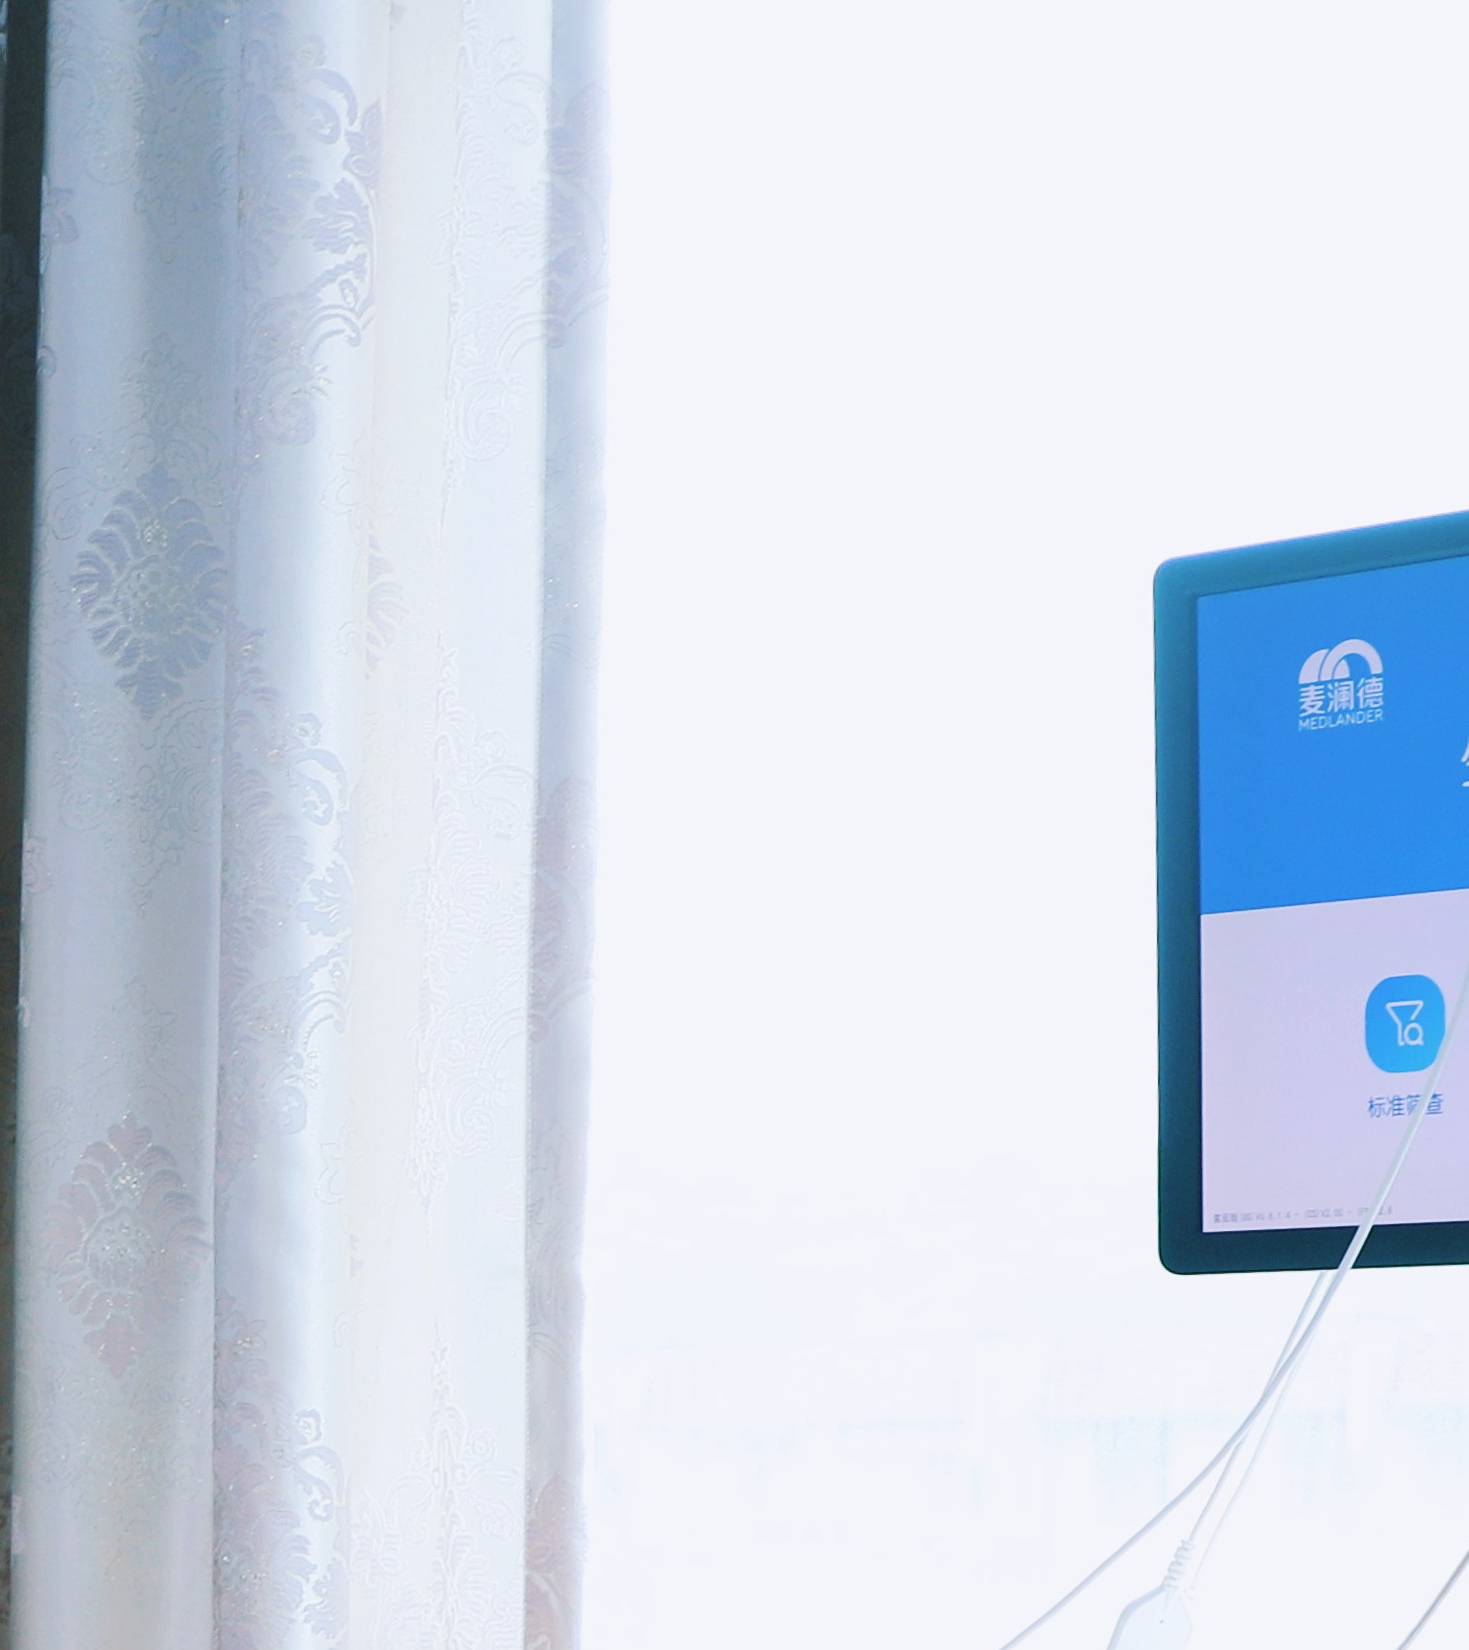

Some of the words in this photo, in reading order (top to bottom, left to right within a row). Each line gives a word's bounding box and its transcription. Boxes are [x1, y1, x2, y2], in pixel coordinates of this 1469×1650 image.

[1299, 677, 1384, 717] 麦澜德
[1299, 709, 1383, 731] MEDLANDER
